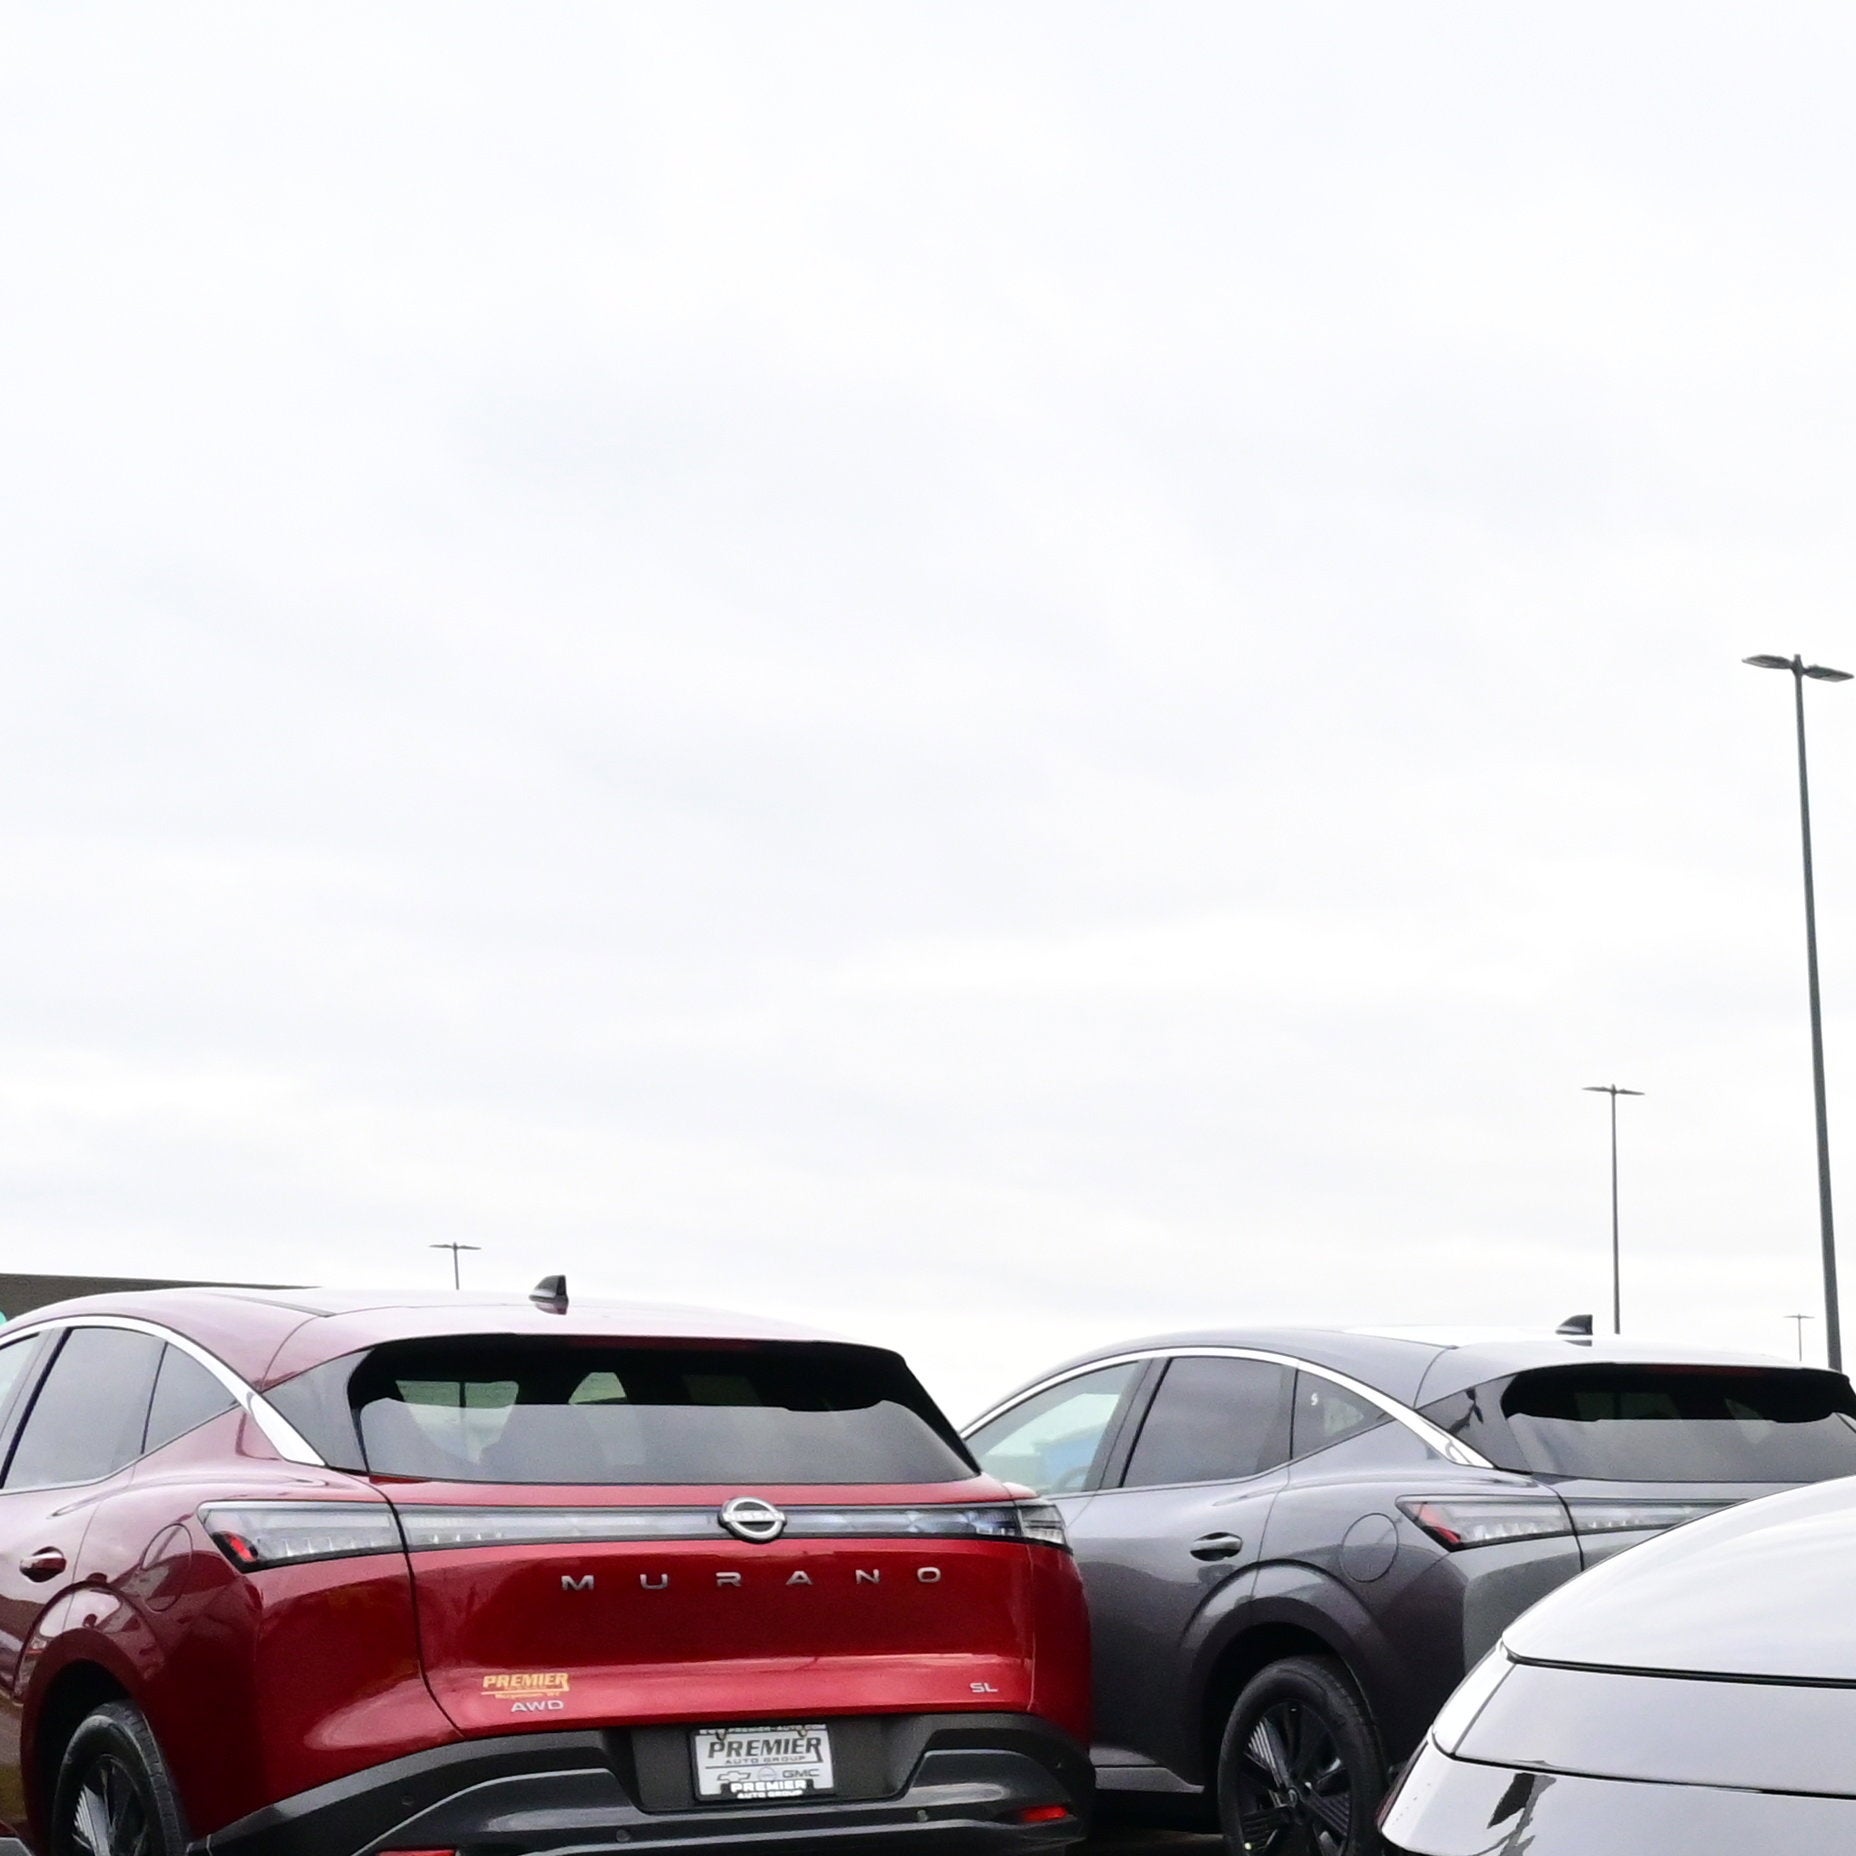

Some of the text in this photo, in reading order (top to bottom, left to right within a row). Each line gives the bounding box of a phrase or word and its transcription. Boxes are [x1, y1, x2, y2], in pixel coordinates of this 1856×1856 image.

[561, 1567, 942, 1591] MURANO
[482, 1673, 570, 1692] PREMIER
[970, 1682, 999, 1693] SL
[511, 1700, 564, 1712] AWD
[708, 1737, 823, 1763] PREMIER
[725, 1755, 806, 1765] AUTO GROUP
[782, 1768, 820, 1778] GMC
[731, 1780, 807, 1792] PREMIER
